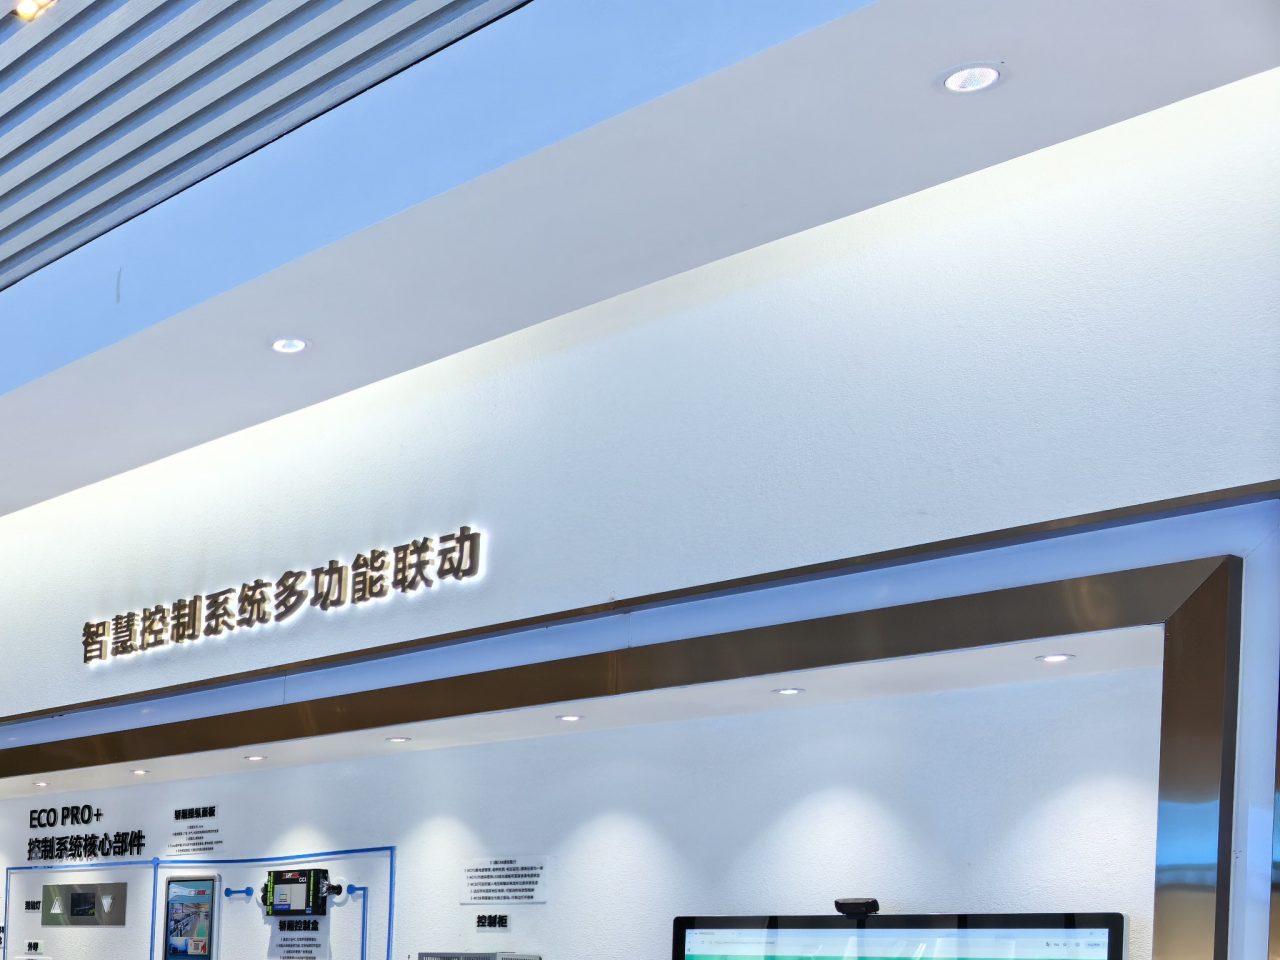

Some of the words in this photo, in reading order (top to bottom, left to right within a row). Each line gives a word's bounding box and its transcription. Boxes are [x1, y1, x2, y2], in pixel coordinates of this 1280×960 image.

[82, 526, 481, 664] 智慧控制系统多功能联动
[29, 808, 58, 829] ECO
[61, 804, 104, 826] PRO+
[27, 829, 145, 861] 控制系统核心部件
[477, 915, 508, 928] 控制柜
[27, 942, 39, 952] 外呼
